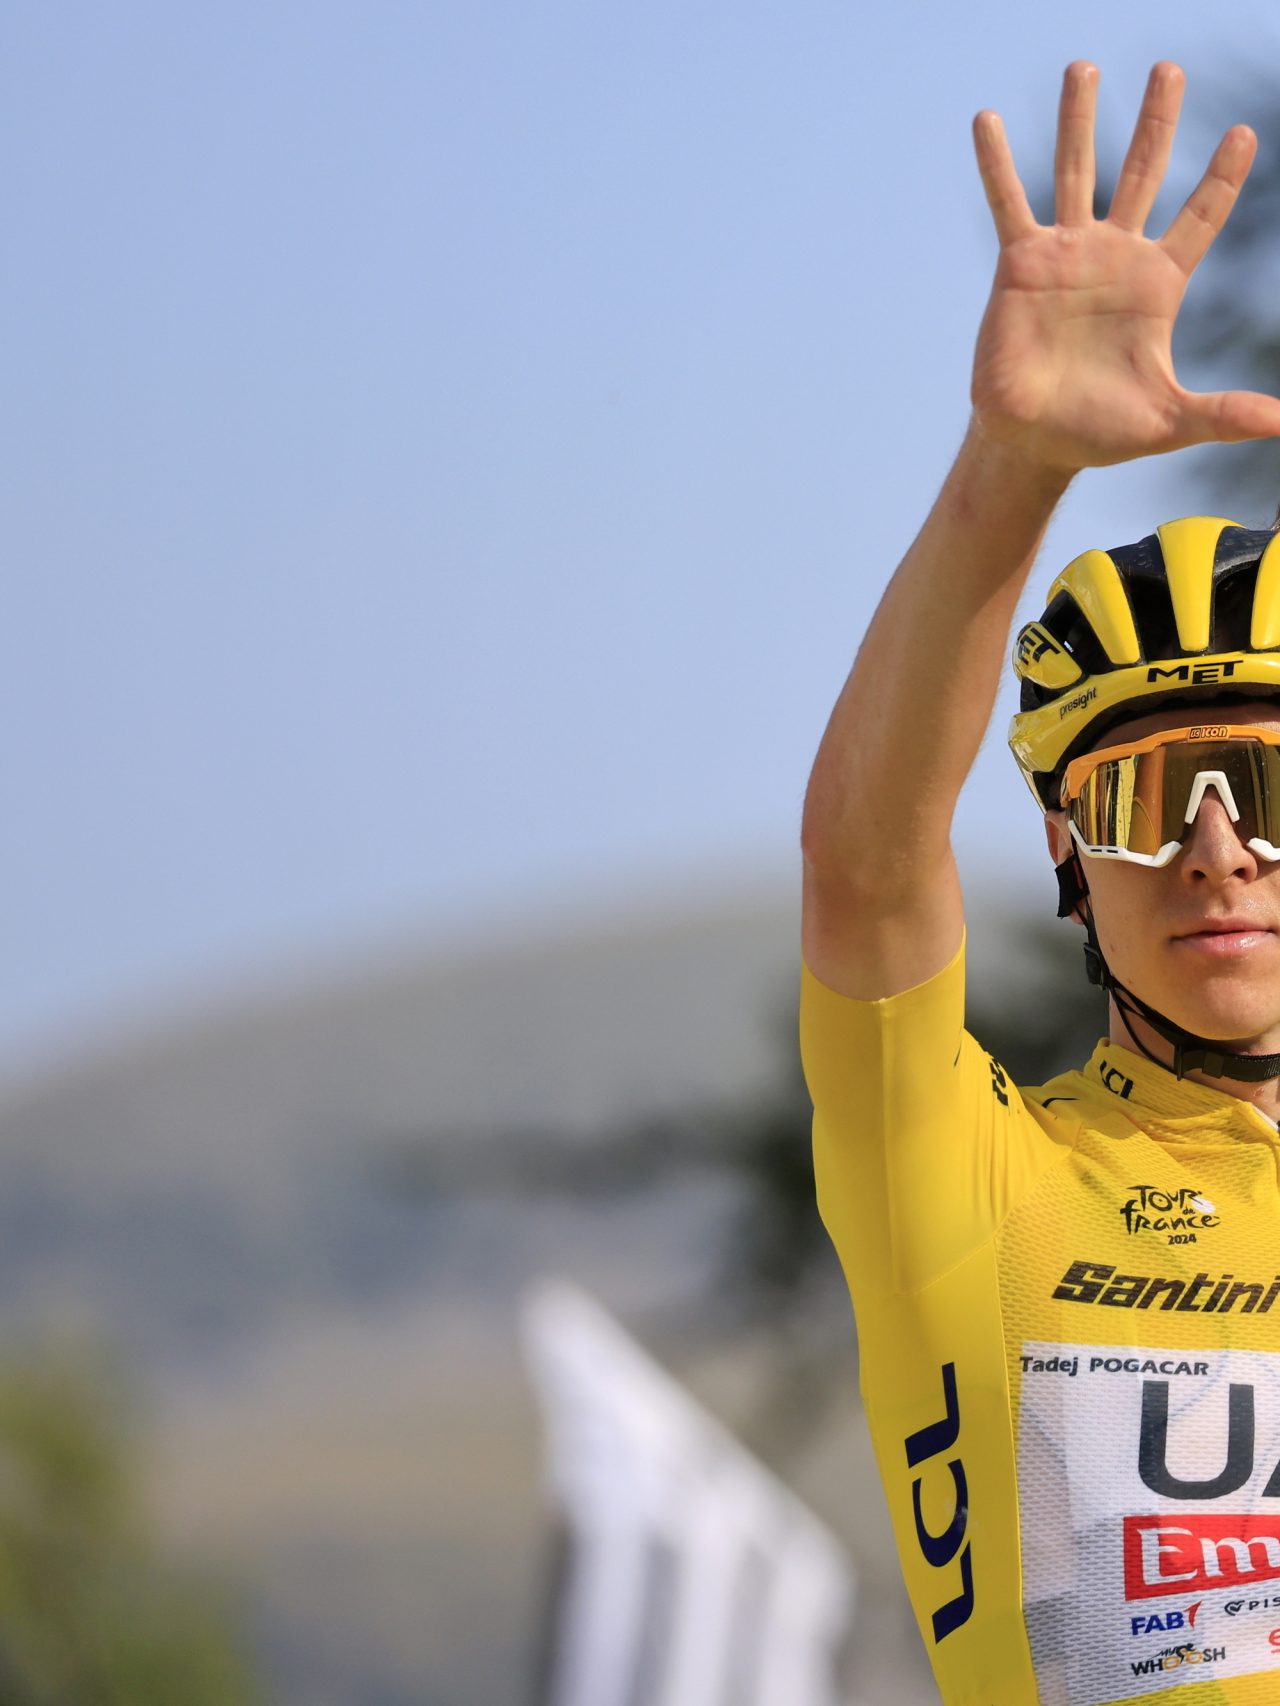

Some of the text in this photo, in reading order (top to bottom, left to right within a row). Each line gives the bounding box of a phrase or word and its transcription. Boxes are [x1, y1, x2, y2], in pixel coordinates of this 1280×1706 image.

[1146, 660, 1245, 685] MET
[1060, 687, 1098, 720] presight
[1168, 1233, 1197, 1246] 2024
[1020, 1356, 1210, 1377] Tadej POGACAR
[904, 1361, 975, 1645] LCL
[1131, 1611, 1185, 1636] FAB
